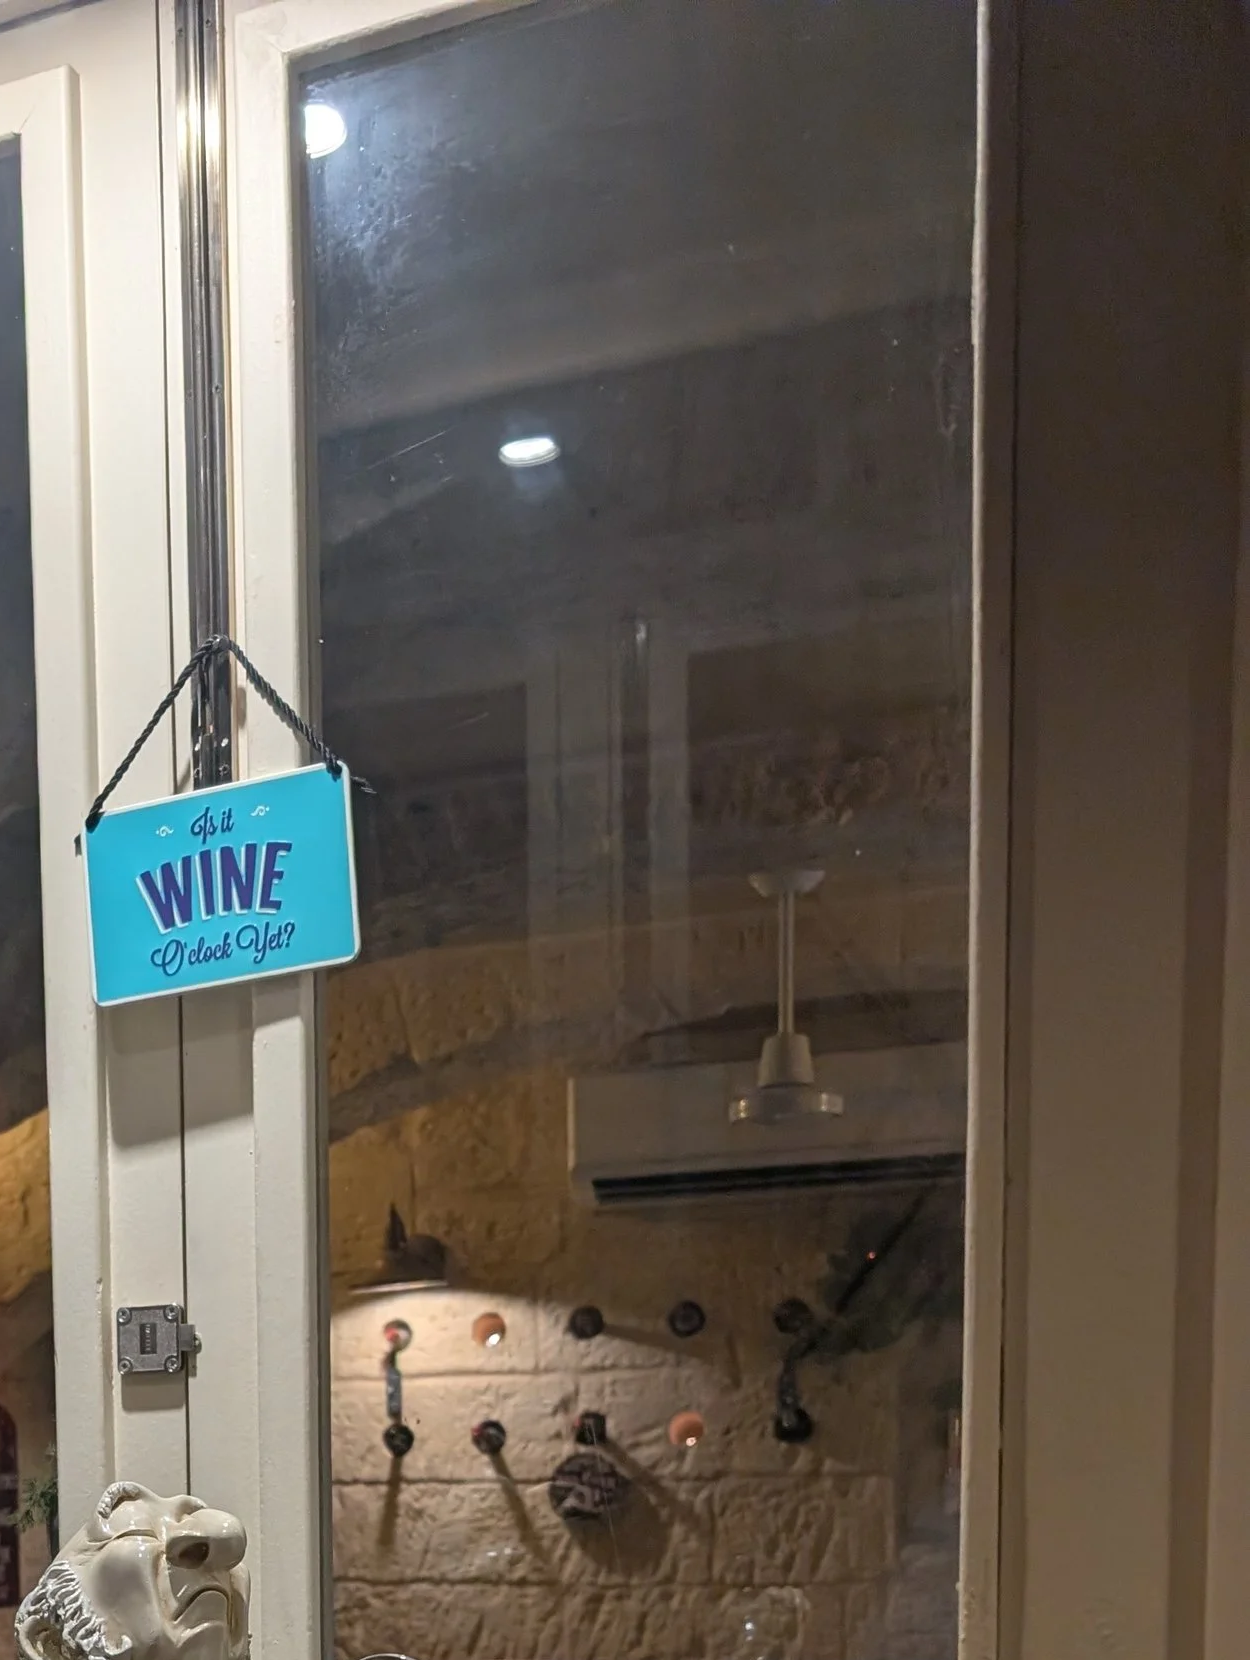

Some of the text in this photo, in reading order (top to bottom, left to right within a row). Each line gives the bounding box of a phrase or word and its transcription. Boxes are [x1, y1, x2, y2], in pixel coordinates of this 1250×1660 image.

[190, 807, 235, 844] Is it
[136, 841, 293, 935] WINE
[150, 921, 296, 976] O'clock Yet?
